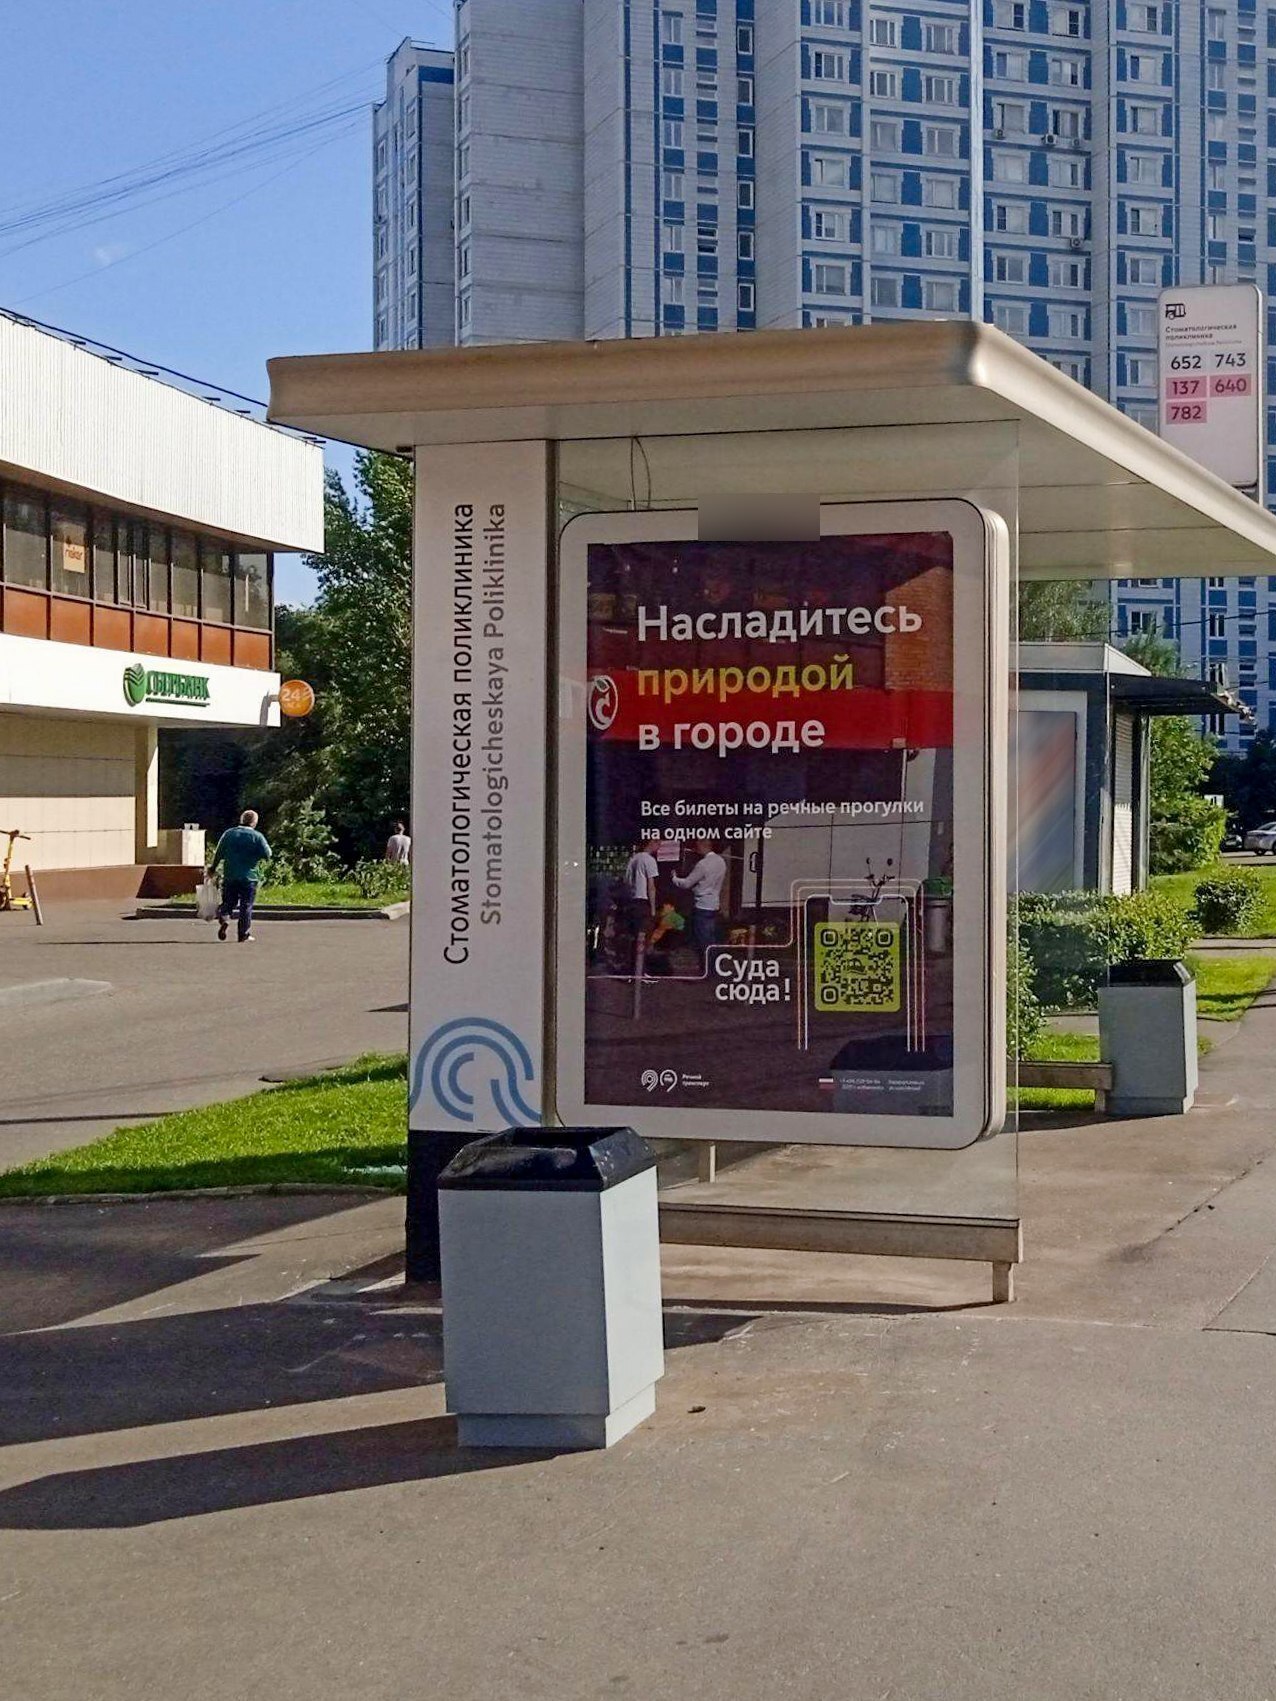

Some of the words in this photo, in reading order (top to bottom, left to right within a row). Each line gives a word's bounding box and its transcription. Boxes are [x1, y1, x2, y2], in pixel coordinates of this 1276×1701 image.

[1170, 355, 1202, 370] 652
[1215, 353, 1246, 368] 743
[1172, 381, 1200, 395] 137
[1215, 378, 1247, 394] 640
[1171, 405, 1202, 420] 782
[482, 504, 505, 638] Poliklinika
[453, 504, 473, 682] поликлиника
[637, 605, 923, 643] Насладитесь
[637, 653, 854, 704] природой
[280, 688, 301, 701] 24
[638, 724, 661, 751] в
[673, 719, 826, 758] городе
[480, 647, 509, 925] Stomatologicheskaya
[641, 800, 671, 817] Все
[674, 799, 739, 816] билеты
[743, 803, 763, 815] на
[767, 801, 836, 818] речные
[840, 800, 924, 818] прогулки
[444, 693, 472, 964] Стоматологическая
[641, 828, 661, 840] на
[664, 827, 721, 842] одном
[724, 823, 773, 839] сайте
[714, 953, 780, 982] Суда
[714, 977, 791, 1005] сюда!
